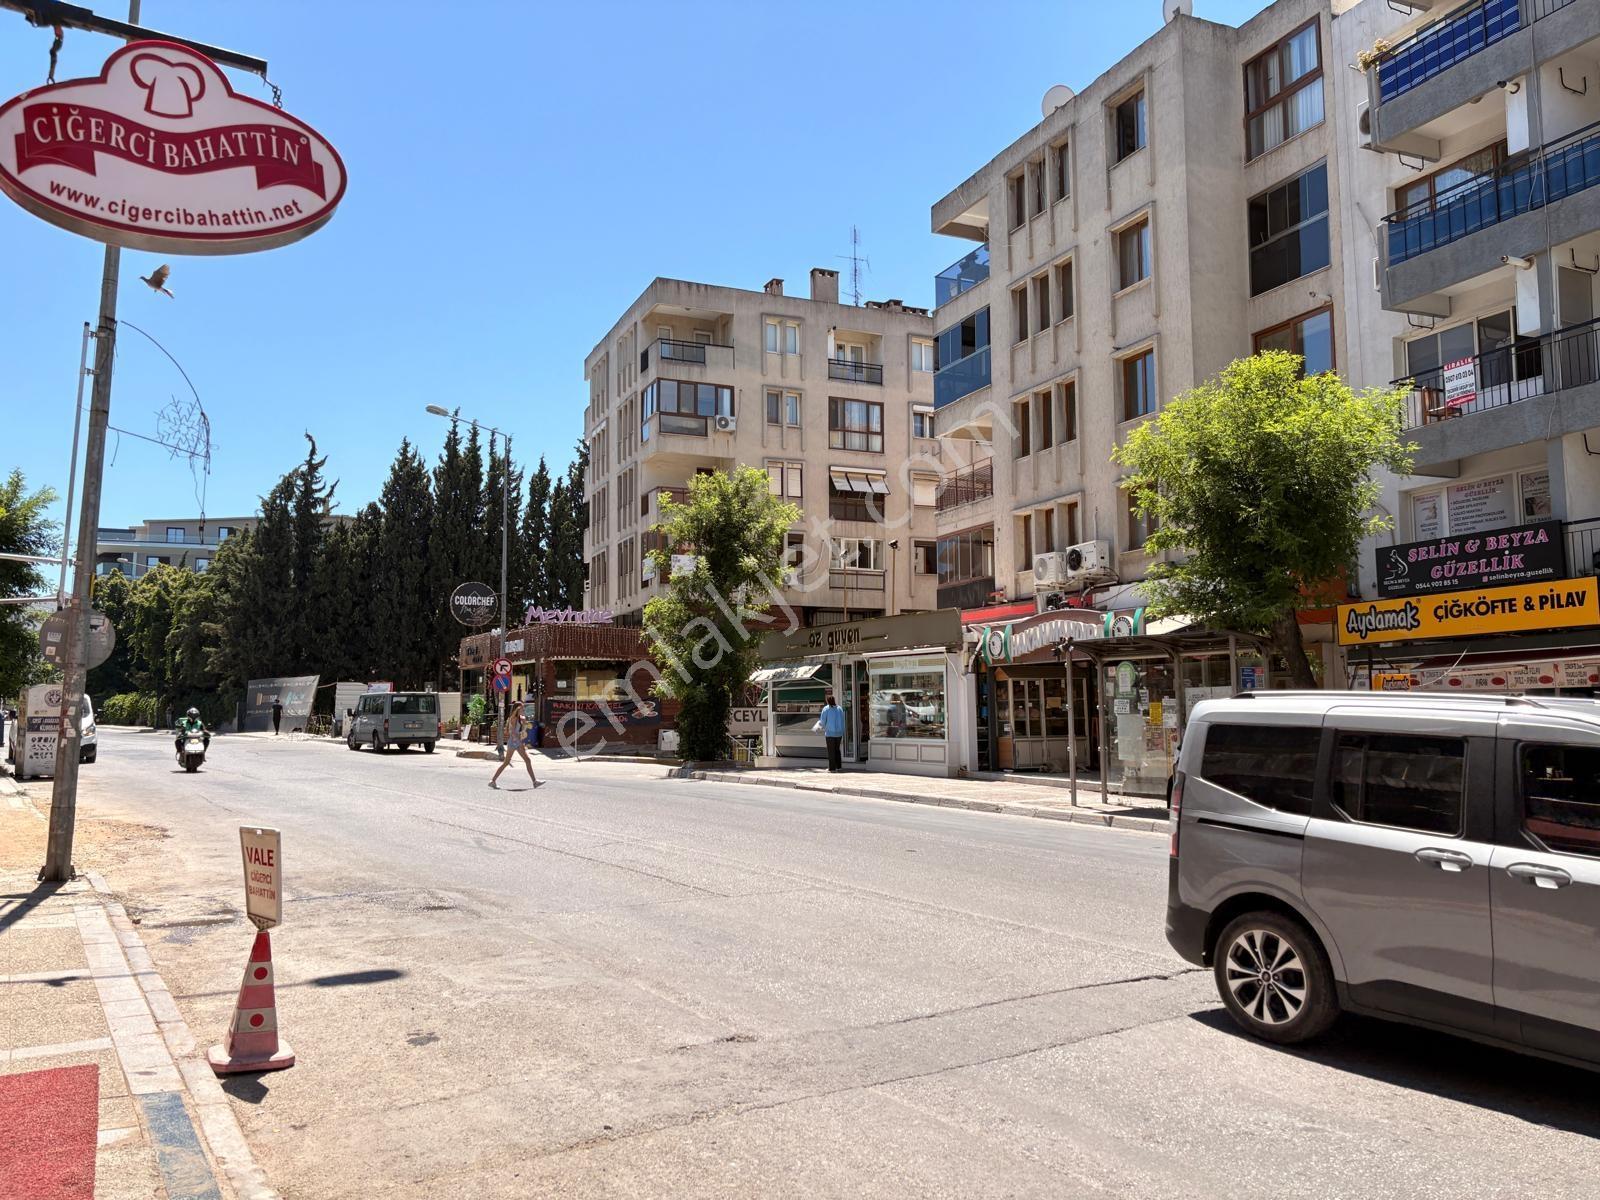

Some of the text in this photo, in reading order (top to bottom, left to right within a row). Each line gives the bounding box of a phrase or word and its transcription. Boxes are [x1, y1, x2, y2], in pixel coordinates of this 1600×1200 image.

[32, 106, 301, 168] CİĞERCİ BAHATTİN
[50, 180, 303, 227] www.cigercibahattin.net
[1407, 528, 1549, 563] SELİN & BEYZA
[1430, 550, 1525, 579] GÜZELLİK
[1415, 580, 1431, 590] 0544
[1452, 578, 1459, 586] 15
[454, 595, 495, 607] COLORCHEF
[1433, 588, 1587, 623] ÇİĞKÖFTE & PİLAV
[525, 605, 614, 624] Meyhane
[1346, 601, 1421, 639] Aydamak
[827, 627, 860, 651] güven
[733, 710, 769, 723] CEYL
[246, 846, 275, 868] VALE
